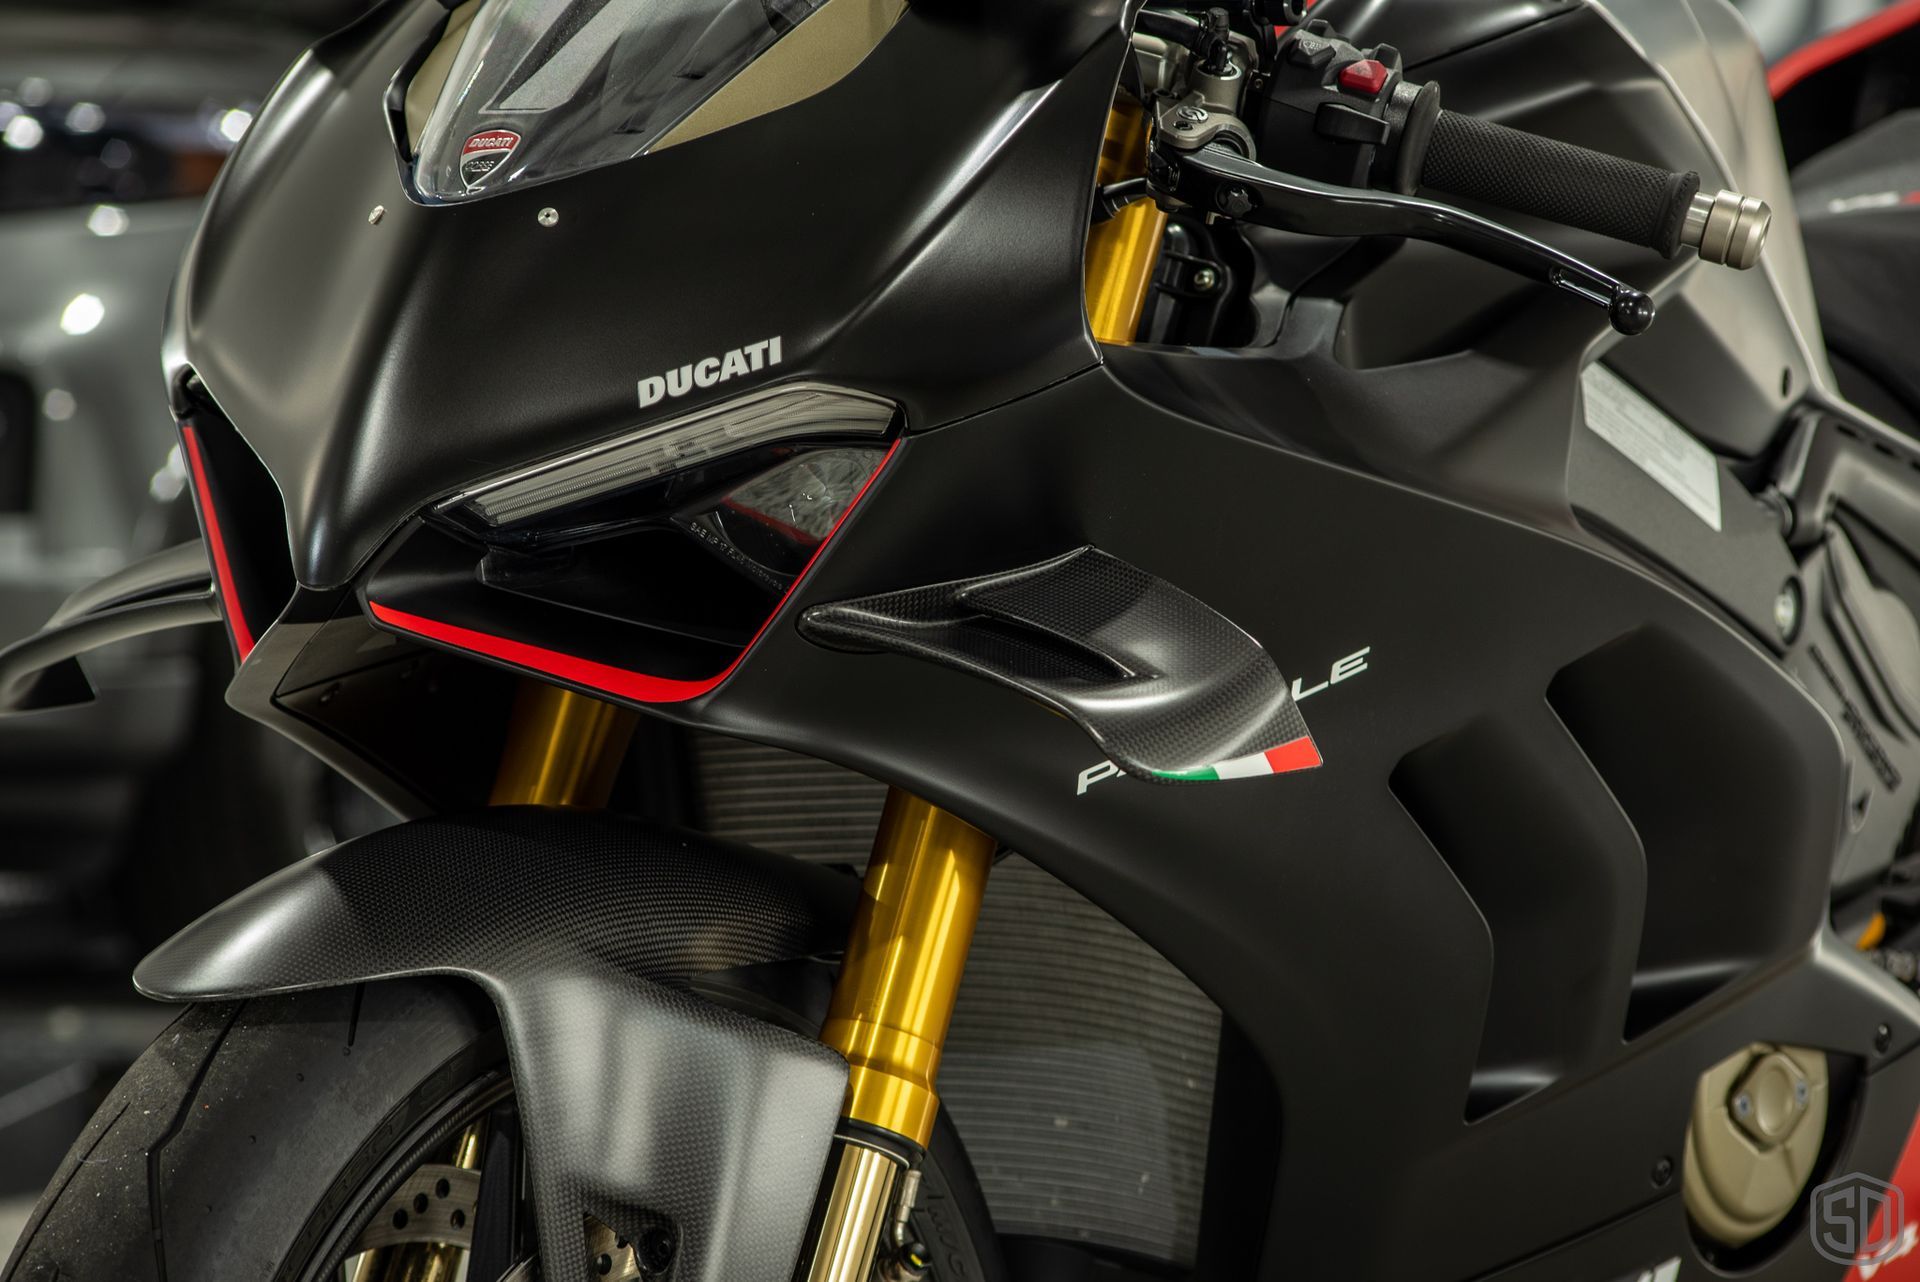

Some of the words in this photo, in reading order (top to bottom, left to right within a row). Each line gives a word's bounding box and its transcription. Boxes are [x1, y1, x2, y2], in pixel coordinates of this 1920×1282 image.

[468, 136, 514, 148] DUCATI
[637, 335, 782, 409] DUCATI
[690, 522, 707, 538] SAE
